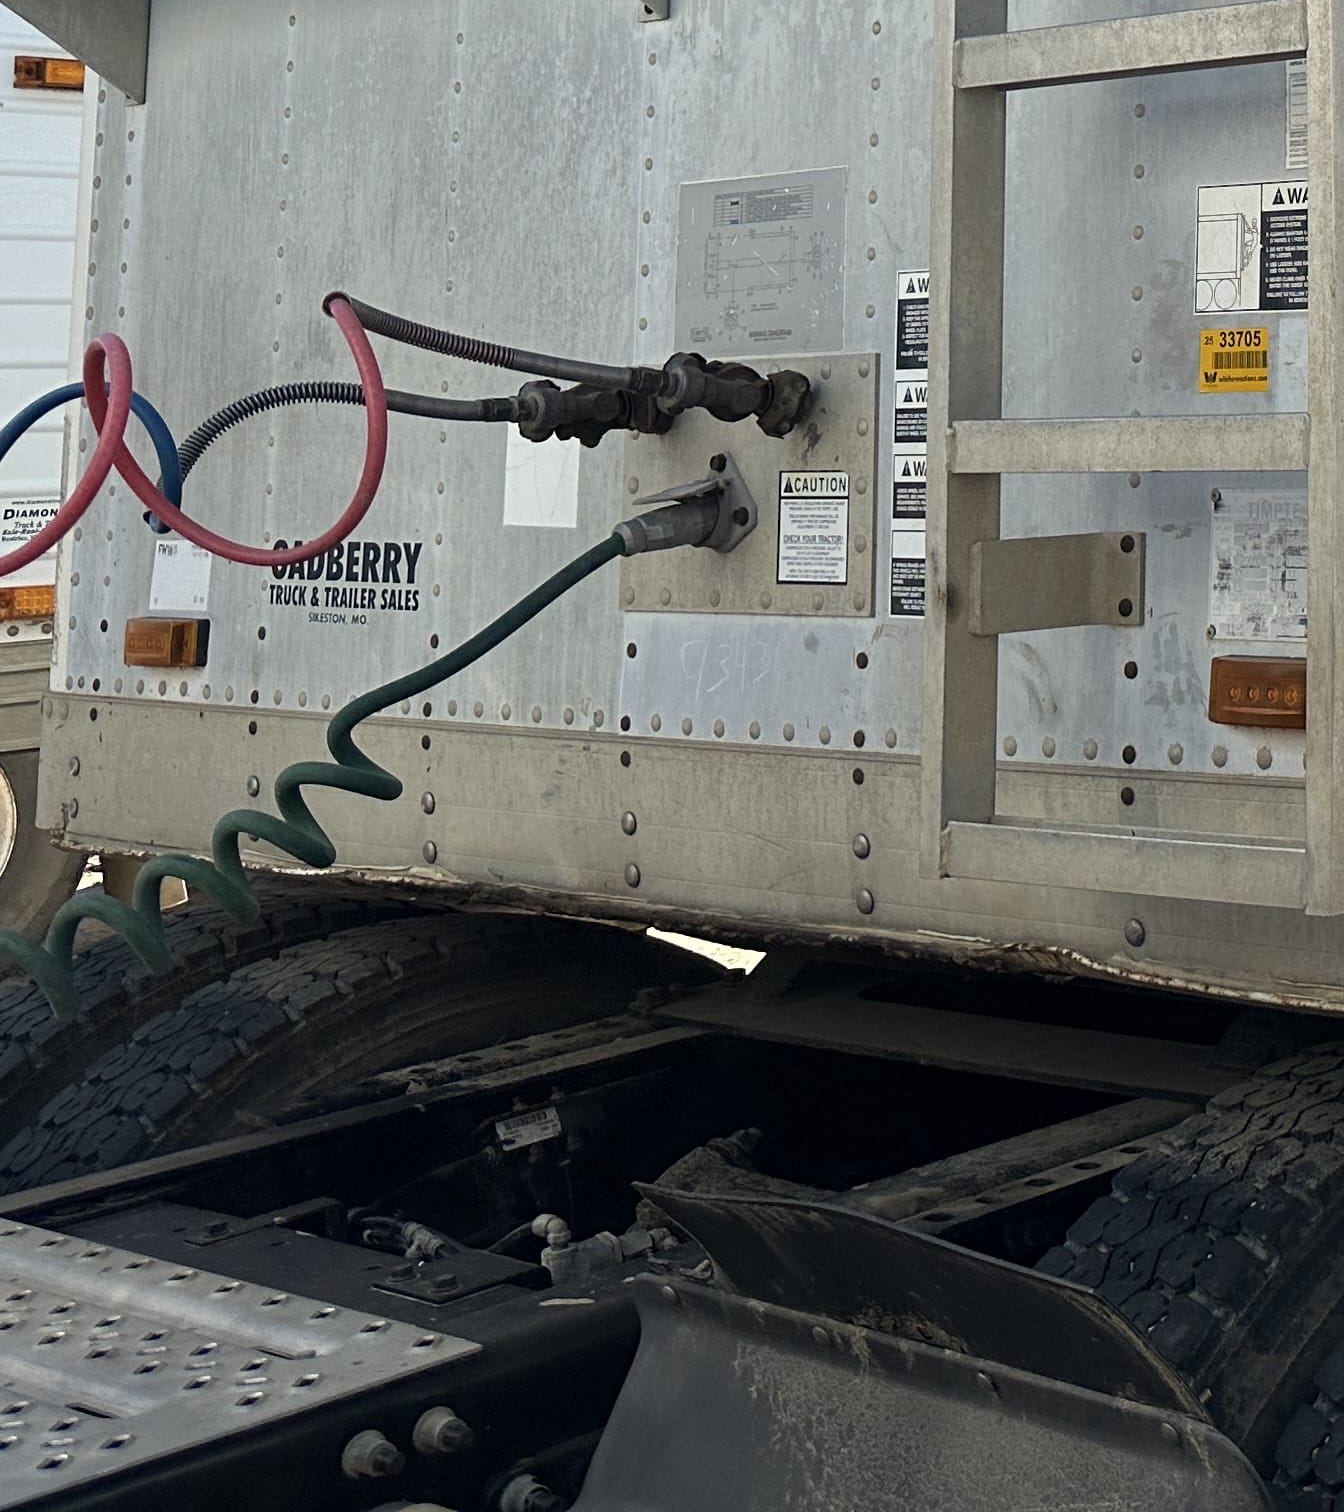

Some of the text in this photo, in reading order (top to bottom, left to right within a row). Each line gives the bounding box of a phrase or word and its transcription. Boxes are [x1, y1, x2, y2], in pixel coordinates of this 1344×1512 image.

[1219, 330, 1261, 347] 33705
[794, 477, 847, 493] CAUTION
[3, 508, 58, 520] DIAMON
[269, 584, 420, 611] TRUCK & TRAILER SALES
